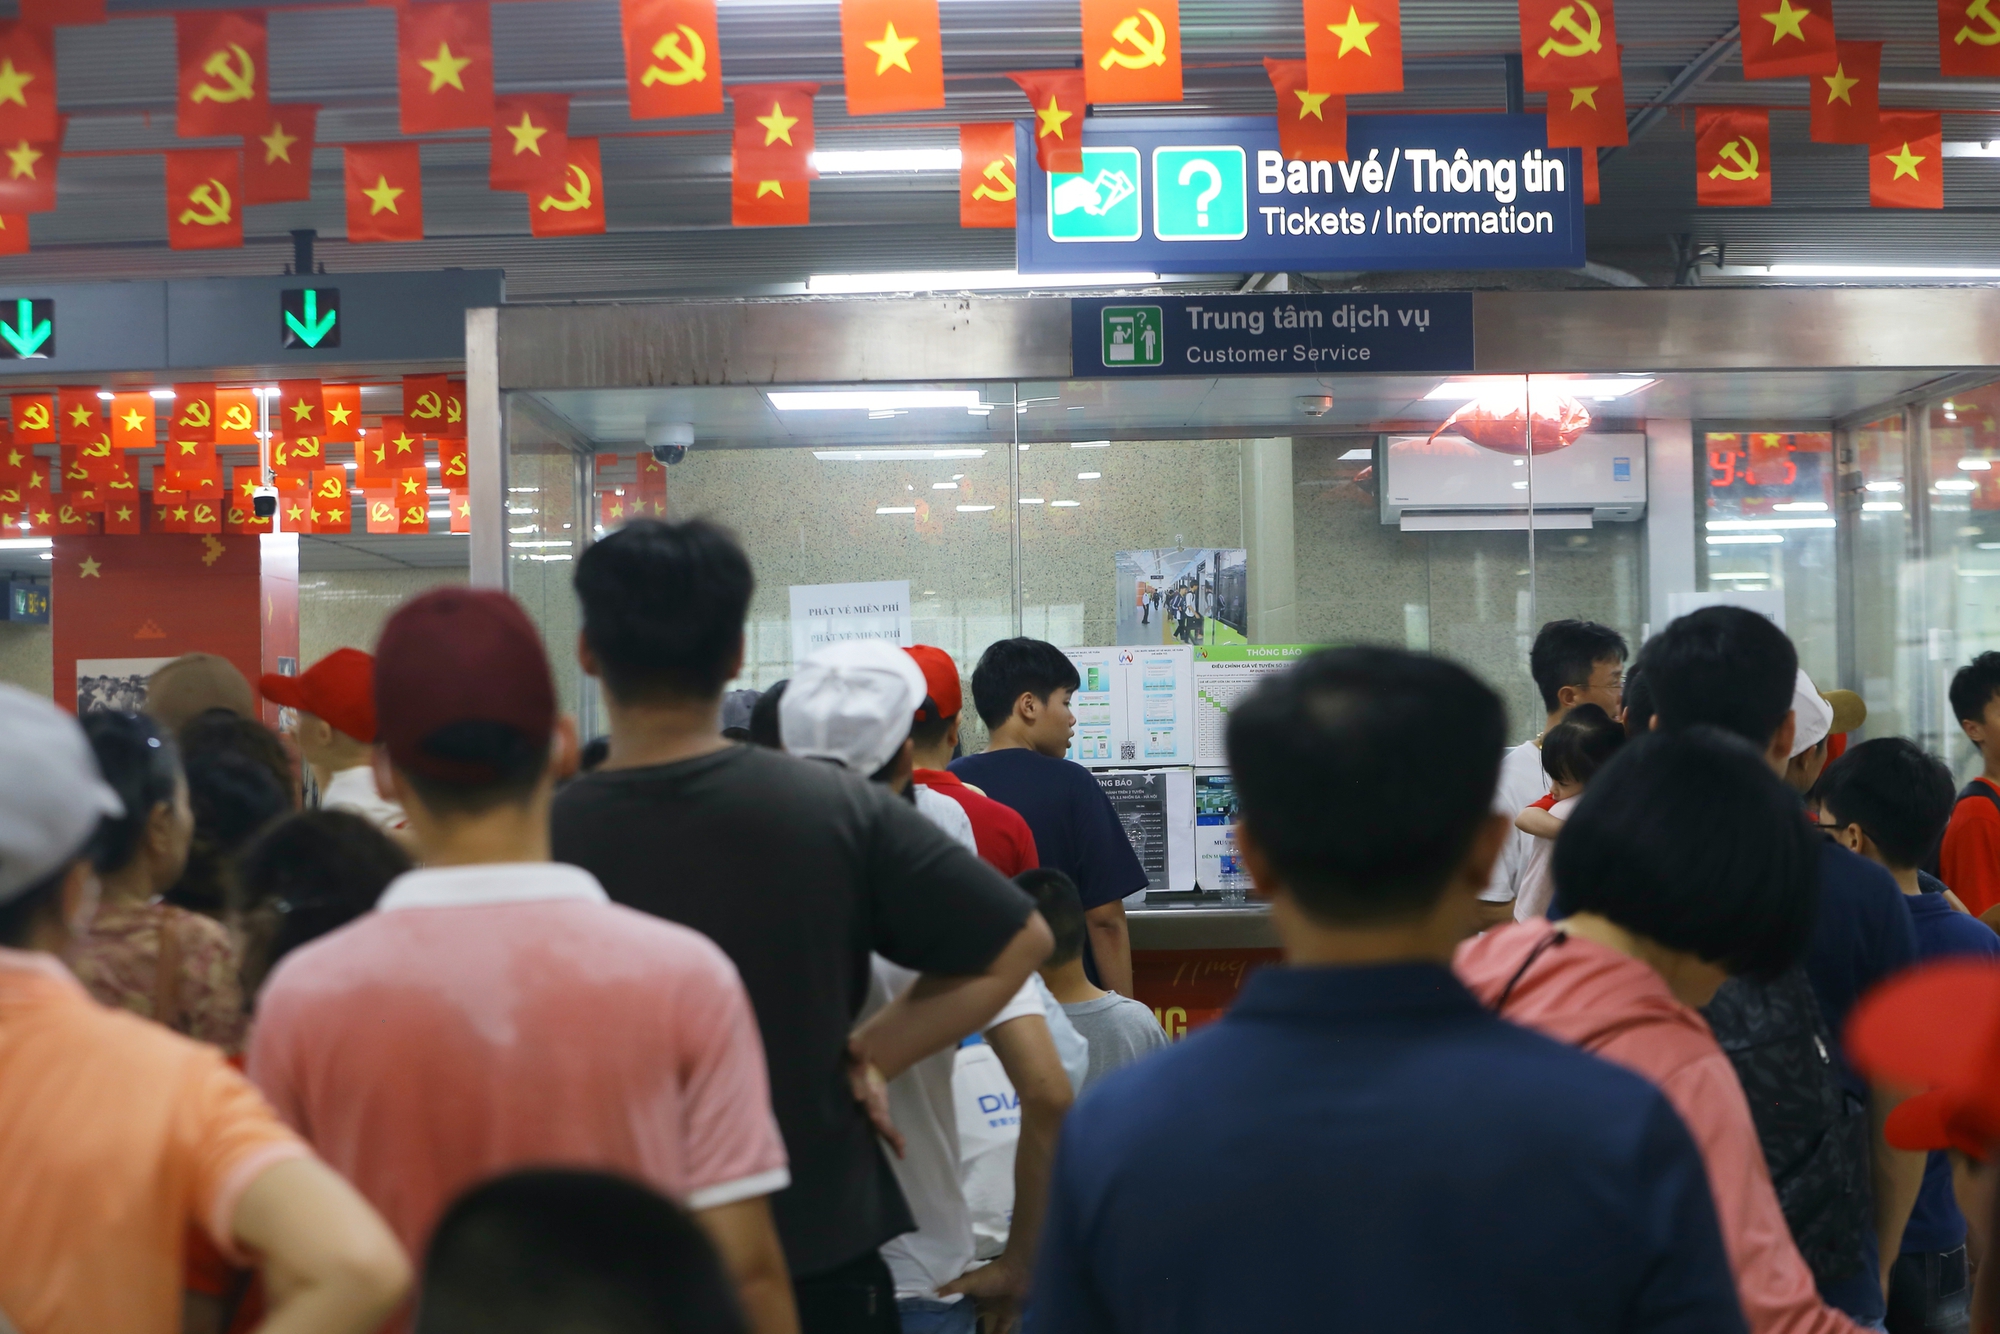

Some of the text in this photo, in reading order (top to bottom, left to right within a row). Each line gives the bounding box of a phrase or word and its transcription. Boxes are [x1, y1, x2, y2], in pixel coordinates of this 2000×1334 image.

[1404, 148, 1517, 203] Thông
[1522, 149, 1565, 192] tin
[1258, 205, 1554, 235] Tickets / Information
[1186, 304, 1430, 335] Trung tâm dịch vụ
[1186, 345, 1371, 363] Customer Service
[809, 606, 836, 616] PHÁT
[837, 605, 851, 615] VÉ
[882, 602, 899, 612] PHÍ
[811, 632, 837, 643] PHÁT
[839, 631, 853, 640] VÉ
[884, 627, 901, 639] PHÍ
[1246, 646, 1302, 656] THÔNG BÁO
[1115, 777, 1133, 787] BÁO
